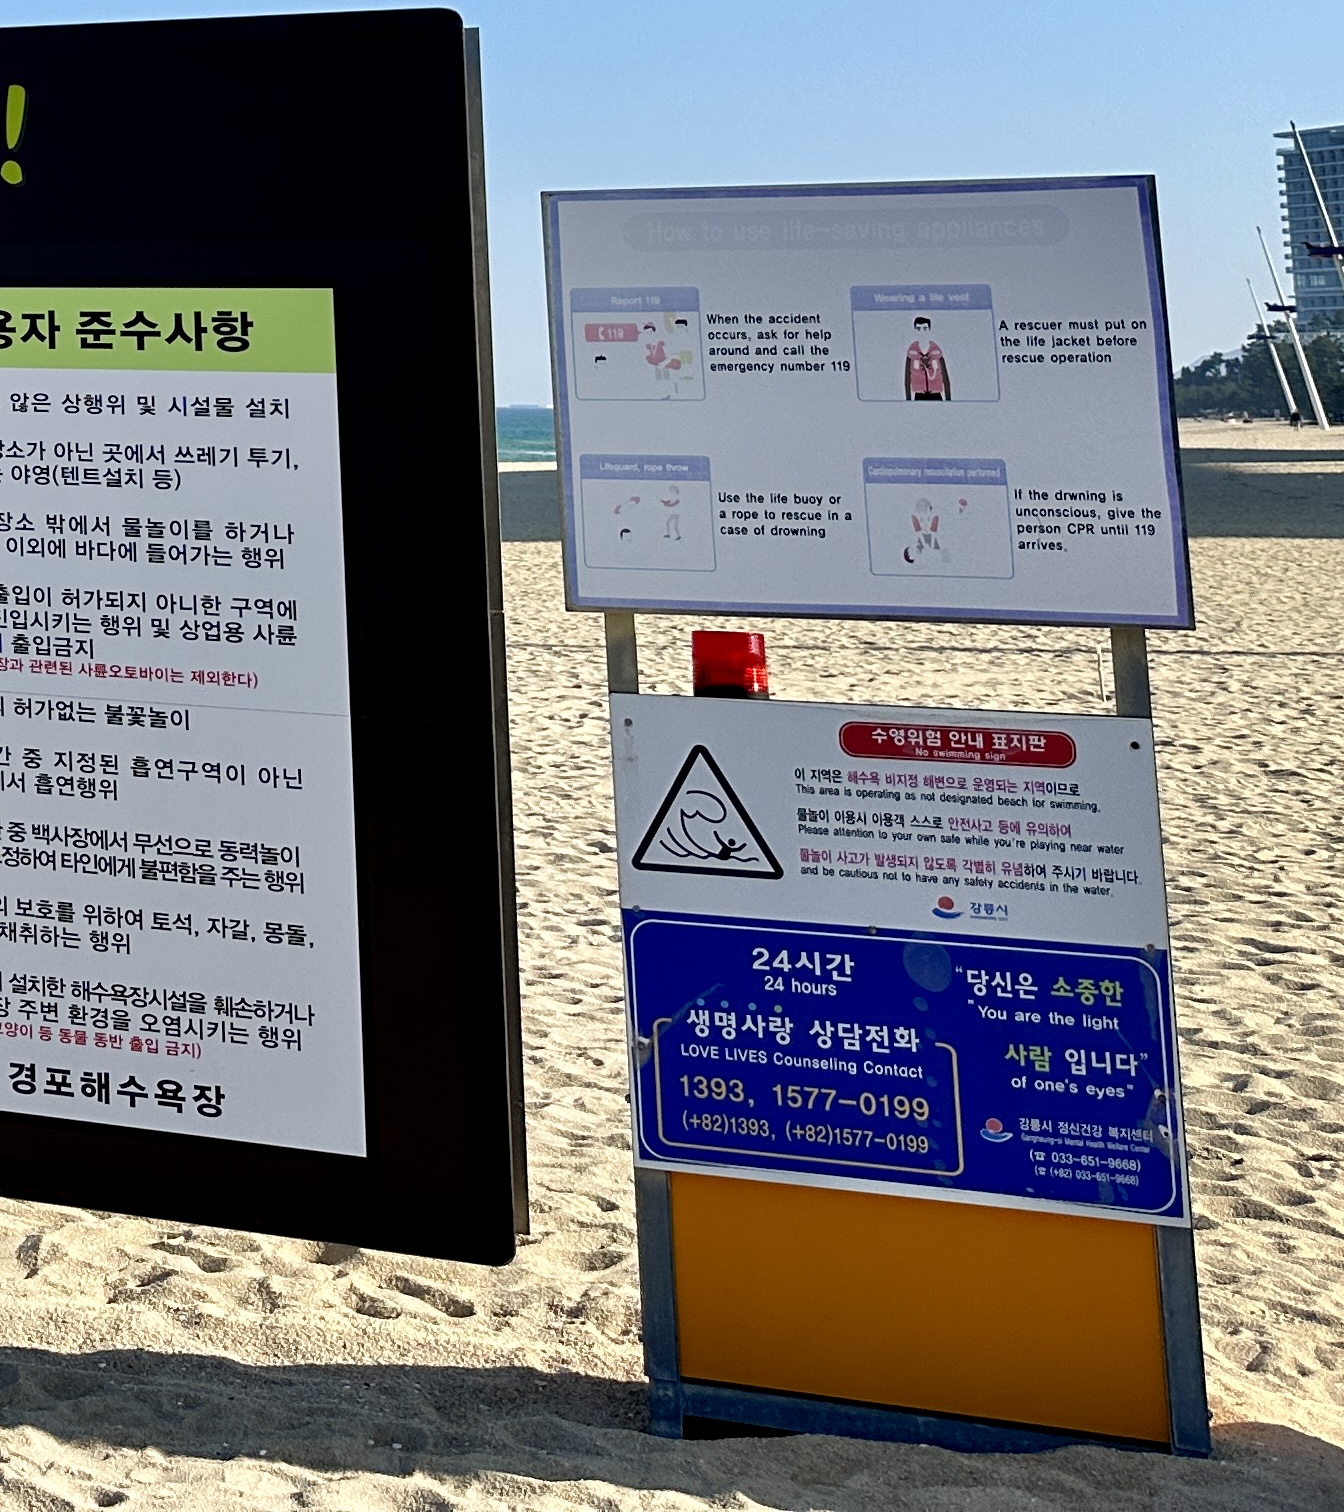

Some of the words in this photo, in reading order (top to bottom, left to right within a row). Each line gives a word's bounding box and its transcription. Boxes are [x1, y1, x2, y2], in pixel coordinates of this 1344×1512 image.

[706, 313, 739, 324] When
[744, 314, 763, 324] the
[768, 313, 821, 324] accident
[998, 319, 1009, 331] A
[1014, 321, 1062, 331] rescuer
[1068, 319, 1099, 330] must
[1104, 319, 1126, 332] put
[1131, 321, 1147, 330] on
[75, 310, 254, 354] 준수사항
[708, 331, 752, 342] occurs,
[757, 329, 778, 340] ask
[783, 329, 800, 340] for
[805, 329, 832, 342] help
[1000, 336, 1021, 347] the
[1026, 335, 1045, 347] life
[1052, 335, 1091, 349] jacket
[1096, 335, 1138, 347] before
[709, 345, 750, 356] around
[755, 345, 778, 356] and
[782, 344, 805, 356] call
[810, 345, 830, 356] the
[1001, 354, 1045, 363] rescue
[1050, 352, 1112, 365] operation
[710, 363, 775, 373] emergency
[780, 361, 825, 372] number
[831, 360, 851, 372] 119
[10, 393, 52, 414] 않은
[61, 394, 126, 416] 상행위
[136, 395, 157, 416] 및
[168, 396, 236, 418] 시설물
[245, 398, 291, 420] 설치
[1014, 488, 1023, 500] If
[1028, 489, 1049, 501] the
[1054, 489, 1107, 504] drwning
[1112, 490, 1124, 502] is
[1015, 506, 1101, 520] unconscious,
[1107, 507, 1135, 520] give
[1141, 507, 1162, 519] the
[1016, 524, 1061, 535] person
[1067, 523, 1095, 535] CPR
[1100, 524, 1129, 536] until
[1134, 524, 1155, 536] 119
[13, 698, 97, 724] 허가없는
[104, 703, 190, 730] 불꽃놀이
[871, 728, 943, 747] 수영위험
[948, 731, 984, 748] 안내
[991, 733, 1046, 752] 표지판
[915, 748, 929, 756] No
[985, 751, 1006, 761] sign
[794, 767, 806, 781] 이
[810, 769, 843, 783] 지역은
[847, 771, 880, 785] 해수욕
[885, 772, 919, 788] 비지정
[923, 775, 967, 790] 해변으로
[751, 947, 855, 982] 24시간
[764, 975, 785, 992] 24
[791, 977, 837, 997] hours
[1050, 976, 1124, 1007] 소중한
[686, 1008, 794, 1046] 생명사랑
[809, 1019, 920, 1054] 상담전화
[1014, 1010, 1042, 1023] are
[1048, 1011, 1075, 1026] the
[1082, 1013, 1120, 1030] light
[38, 1026, 53, 1042] 등
[58, 1028, 88, 1046] 동물
[93, 1032, 124, 1050] 동반
[129, 1035, 160, 1054] 출입
[164, 1040, 202, 1060] 금지)
[680, 1043, 719, 1060] LOVE
[725, 1047, 767, 1064] LIVES
[773, 1052, 857, 1075] Counseling
[863, 1060, 923, 1079] Contact
[1004, 1043, 1052, 1072] 사람
[8, 1061, 226, 1119] 경포해수욕장
[1011, 1076, 1027, 1089] of
[679, 1074, 755, 1108] 1393,
[772, 1083, 930, 1122] 1577-0199
[785, 1120, 929, 1154] (+82)1577-0199
